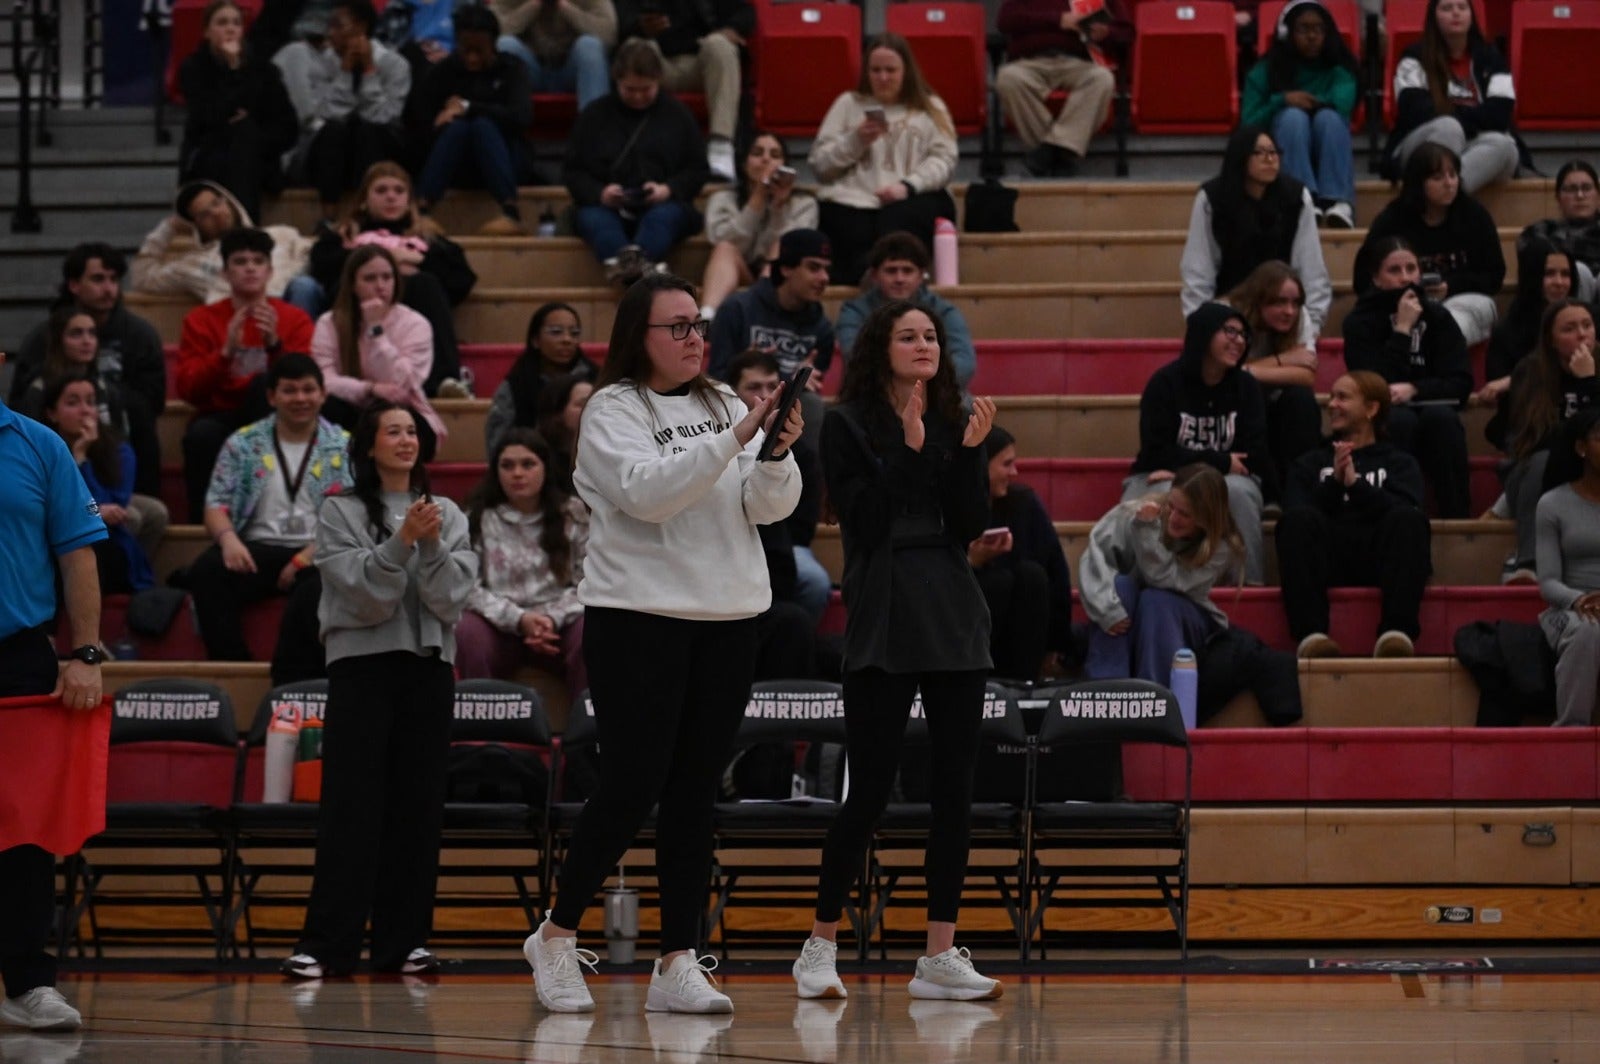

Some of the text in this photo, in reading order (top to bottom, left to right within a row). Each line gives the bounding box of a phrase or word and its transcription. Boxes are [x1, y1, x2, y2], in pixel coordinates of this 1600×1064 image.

[126, 692, 148, 700] EAST
[282, 692, 304, 700] EAST
[777, 692, 838, 700] STROUDSBURG
[1070, 691, 1156, 699] EAST STROUDSBURG
[115, 701, 220, 719] WARRIORS
[454, 701, 532, 720] RRIORS
[744, 700, 845, 719] WARRIORS
[1060, 699, 1167, 718] WARRIORS
